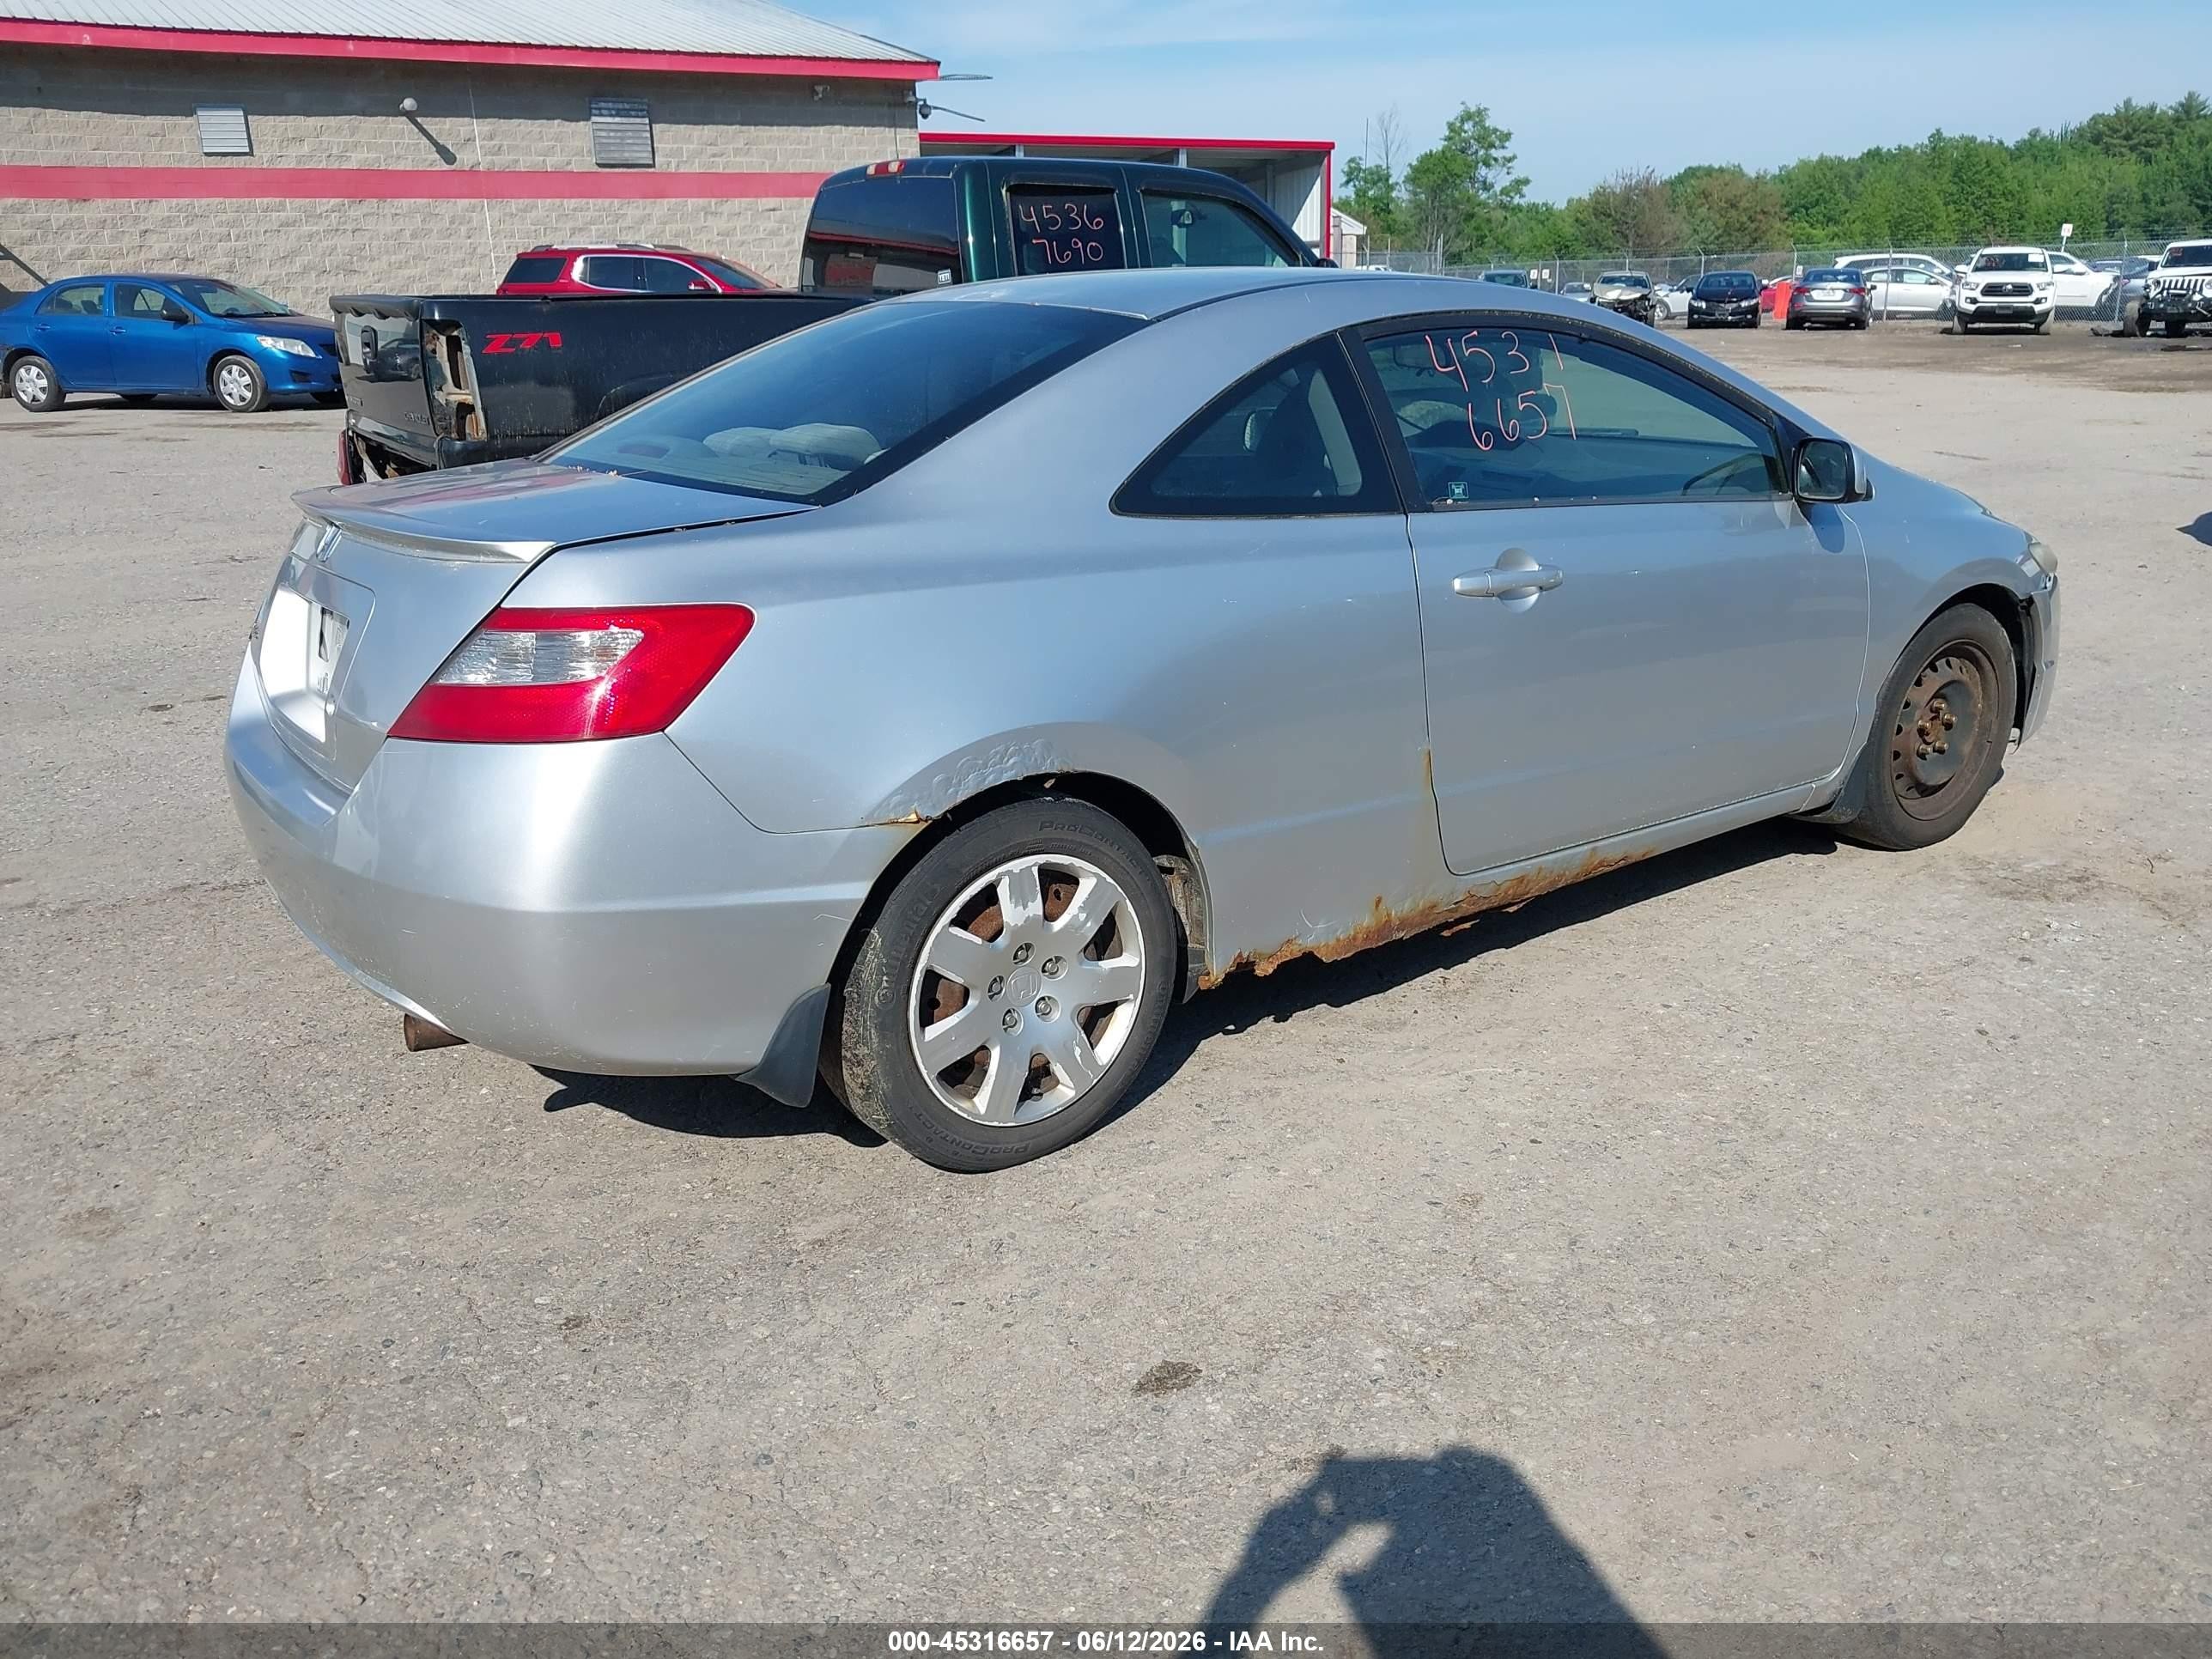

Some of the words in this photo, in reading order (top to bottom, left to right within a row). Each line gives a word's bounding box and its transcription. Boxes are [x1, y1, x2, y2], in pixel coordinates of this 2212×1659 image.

[1019, 204, 1104, 234] 4536
[1031, 237, 1104, 264] 7690
[481, 331, 563, 355] Z71
[1425, 330, 1565, 392] 4531
[1468, 382, 1577, 452] 6657
